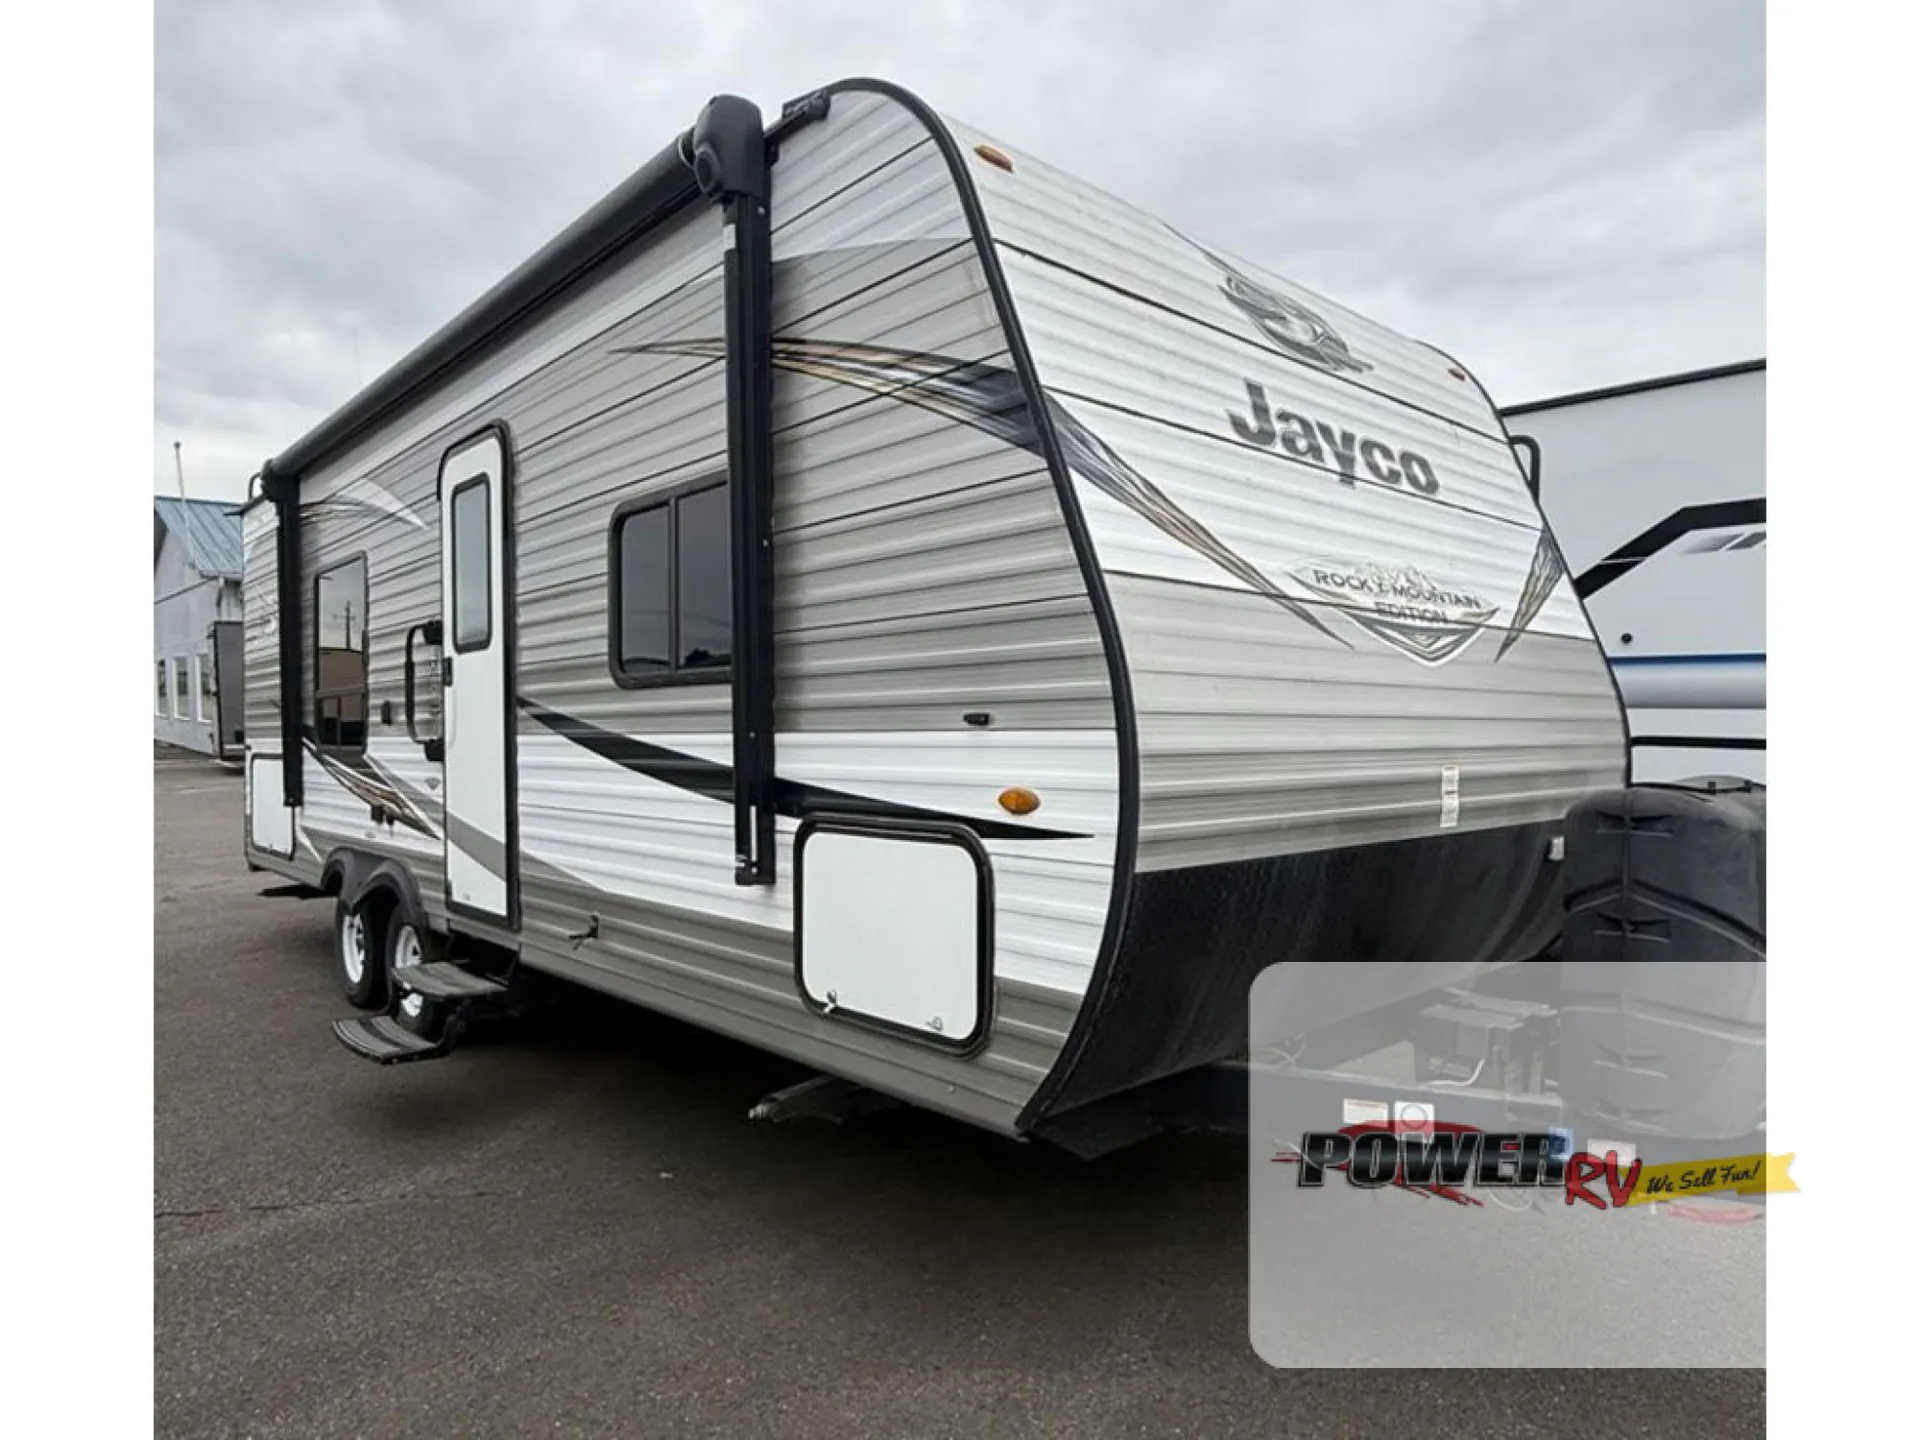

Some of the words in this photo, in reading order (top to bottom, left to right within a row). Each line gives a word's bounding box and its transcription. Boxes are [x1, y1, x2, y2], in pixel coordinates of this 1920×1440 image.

[1226, 376, 1440, 494] Jayco
[1312, 569, 1385, 593] ROCKY
[1391, 583, 1481, 609] MOUNTAIN
[1374, 600, 1449, 623] EDITION
